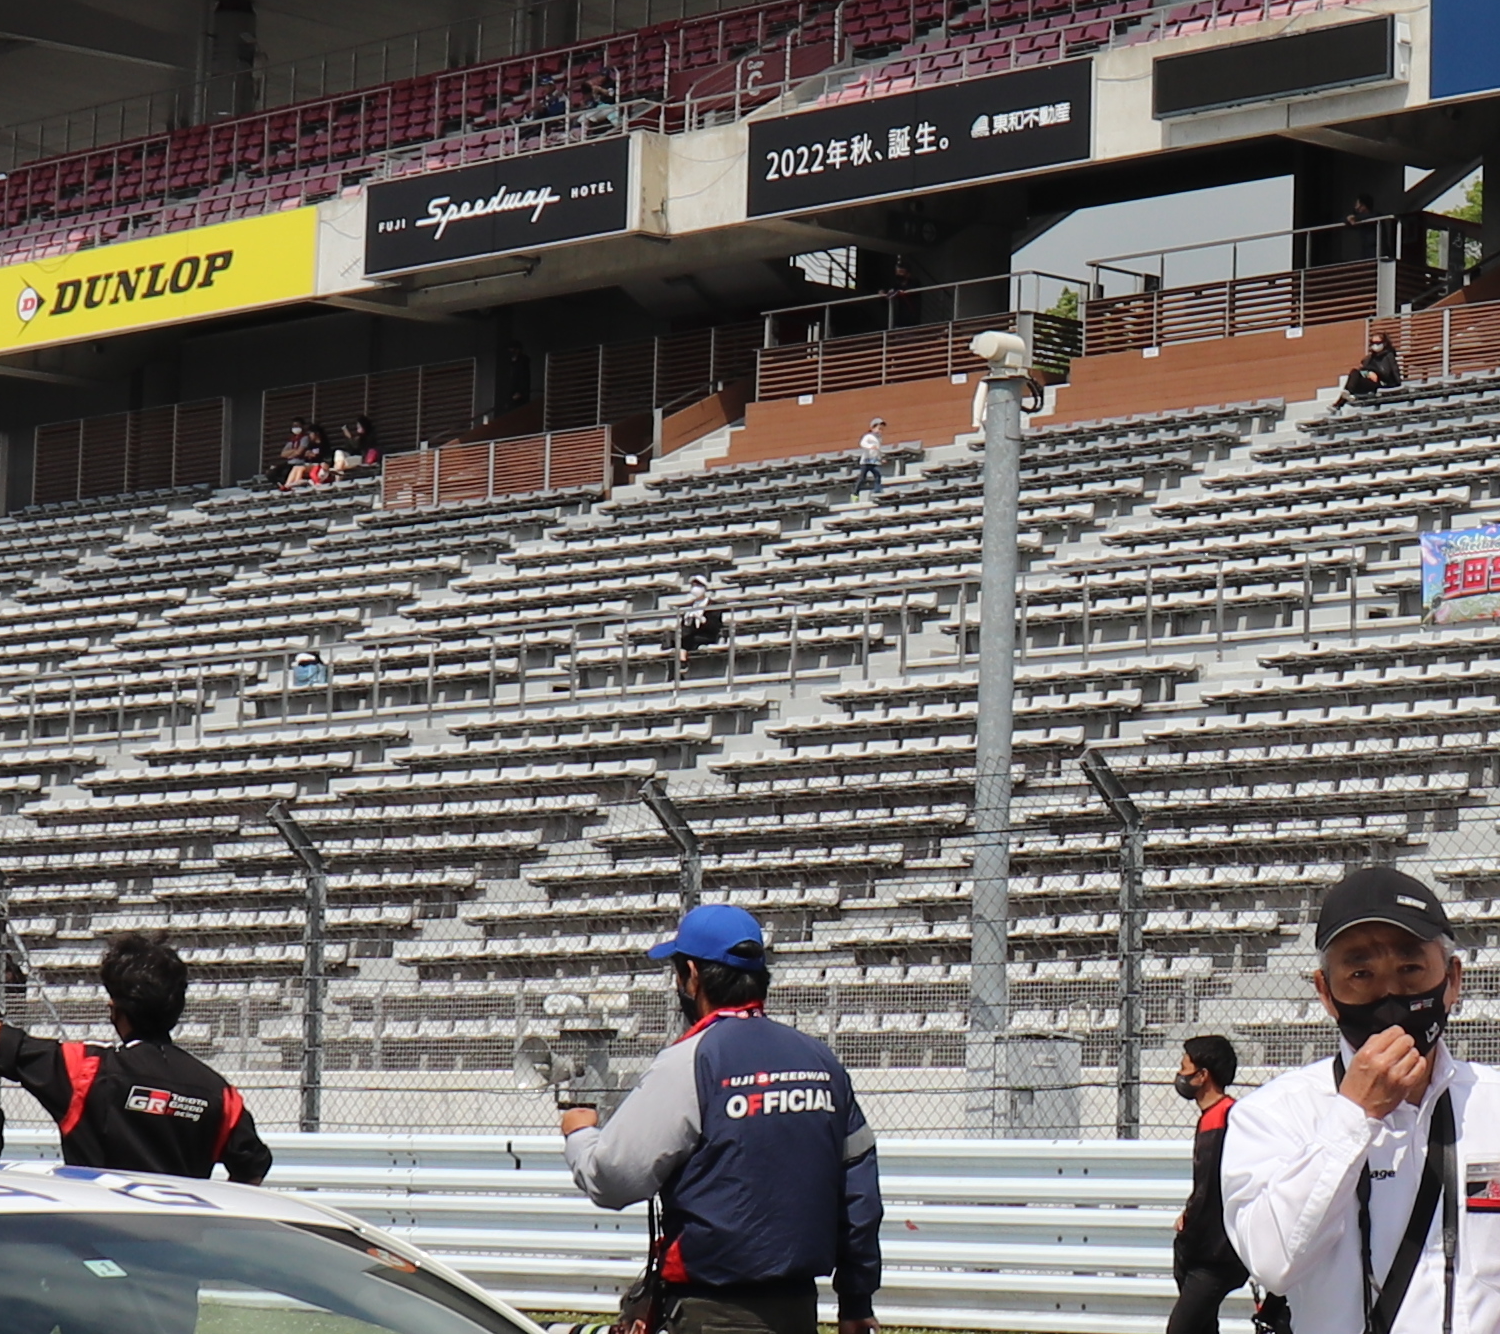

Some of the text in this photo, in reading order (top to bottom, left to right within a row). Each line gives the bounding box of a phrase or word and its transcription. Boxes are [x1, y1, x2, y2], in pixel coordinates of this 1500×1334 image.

[992, 102, 1071, 136] 東和不動産
[378, 181, 613, 240] FUJI Speedway HOTEL
[49, 250, 233, 316] DUNLOP
[756, 1071, 831, 1086] SPEEDWAY
[128, 1095, 168, 1115] GR
[726, 1088, 835, 1118] OFFICIAL
